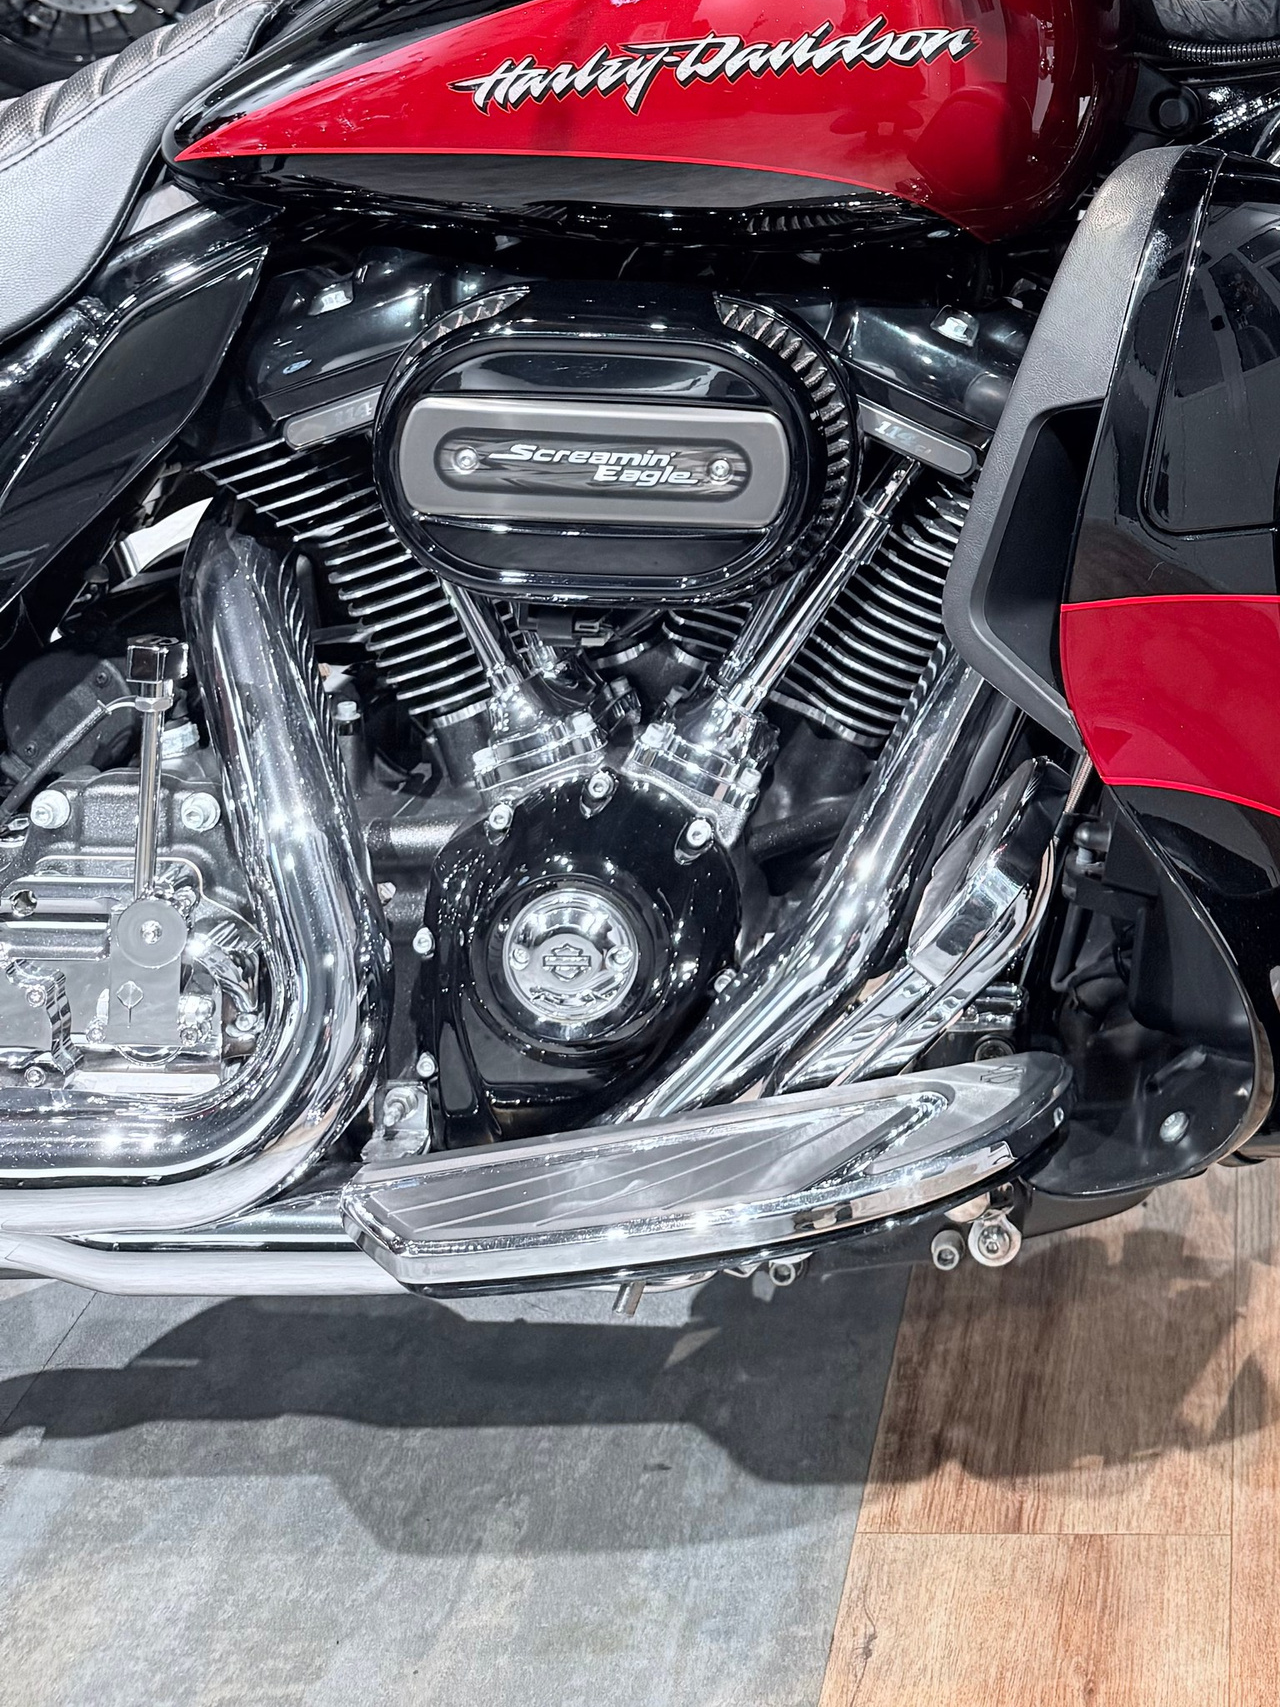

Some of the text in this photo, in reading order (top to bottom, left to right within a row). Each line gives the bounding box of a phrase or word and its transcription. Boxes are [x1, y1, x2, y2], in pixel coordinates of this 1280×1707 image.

[447, 13, 981, 115] Harley-Davidson
[874, 420, 917, 447] 114
[488, 444, 676, 467] Screamin'
[593, 465, 699, 487] Eagle
